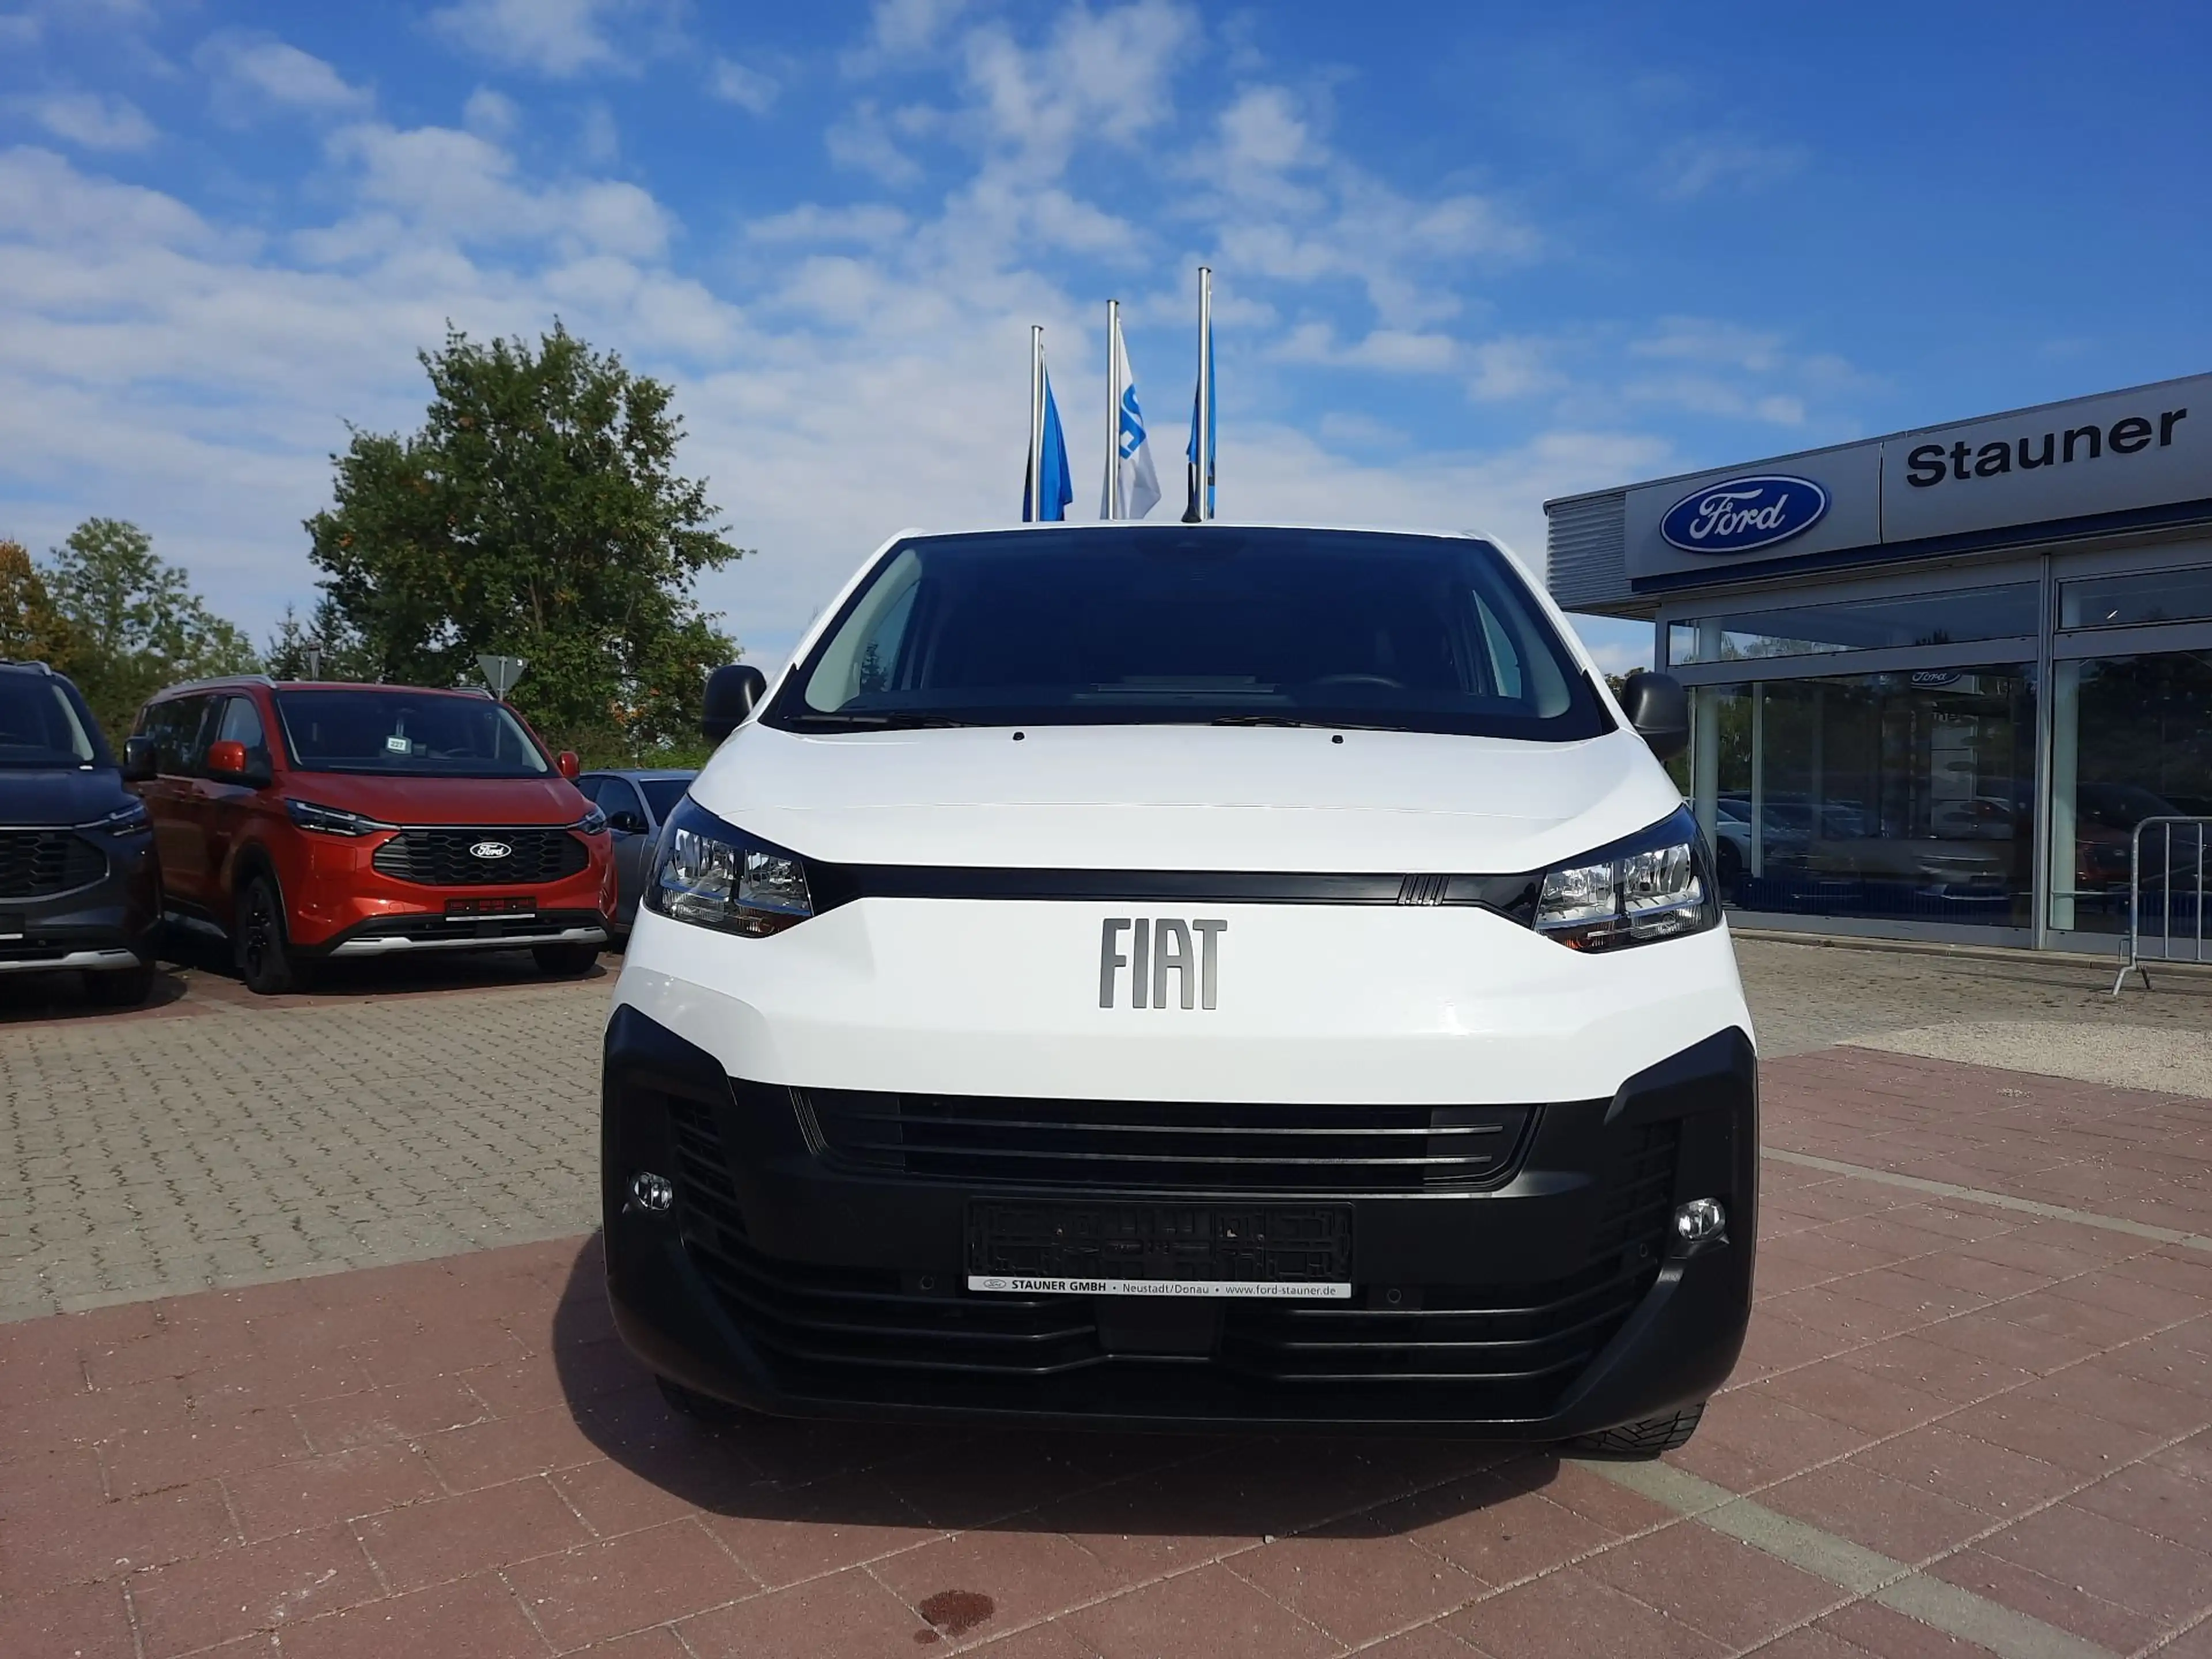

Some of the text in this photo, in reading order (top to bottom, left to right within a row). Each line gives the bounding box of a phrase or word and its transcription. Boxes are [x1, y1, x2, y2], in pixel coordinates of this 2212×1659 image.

[1906, 408, 2188, 488] Stauner
[1689, 488, 1789, 539] Ford
[477, 844, 505, 856] Ford
[1099, 918, 1228, 1010] FIAT
[1012, 1280, 1336, 1296] STAUNER GMBH Neustadt/Donau www.ford-stauner.de
